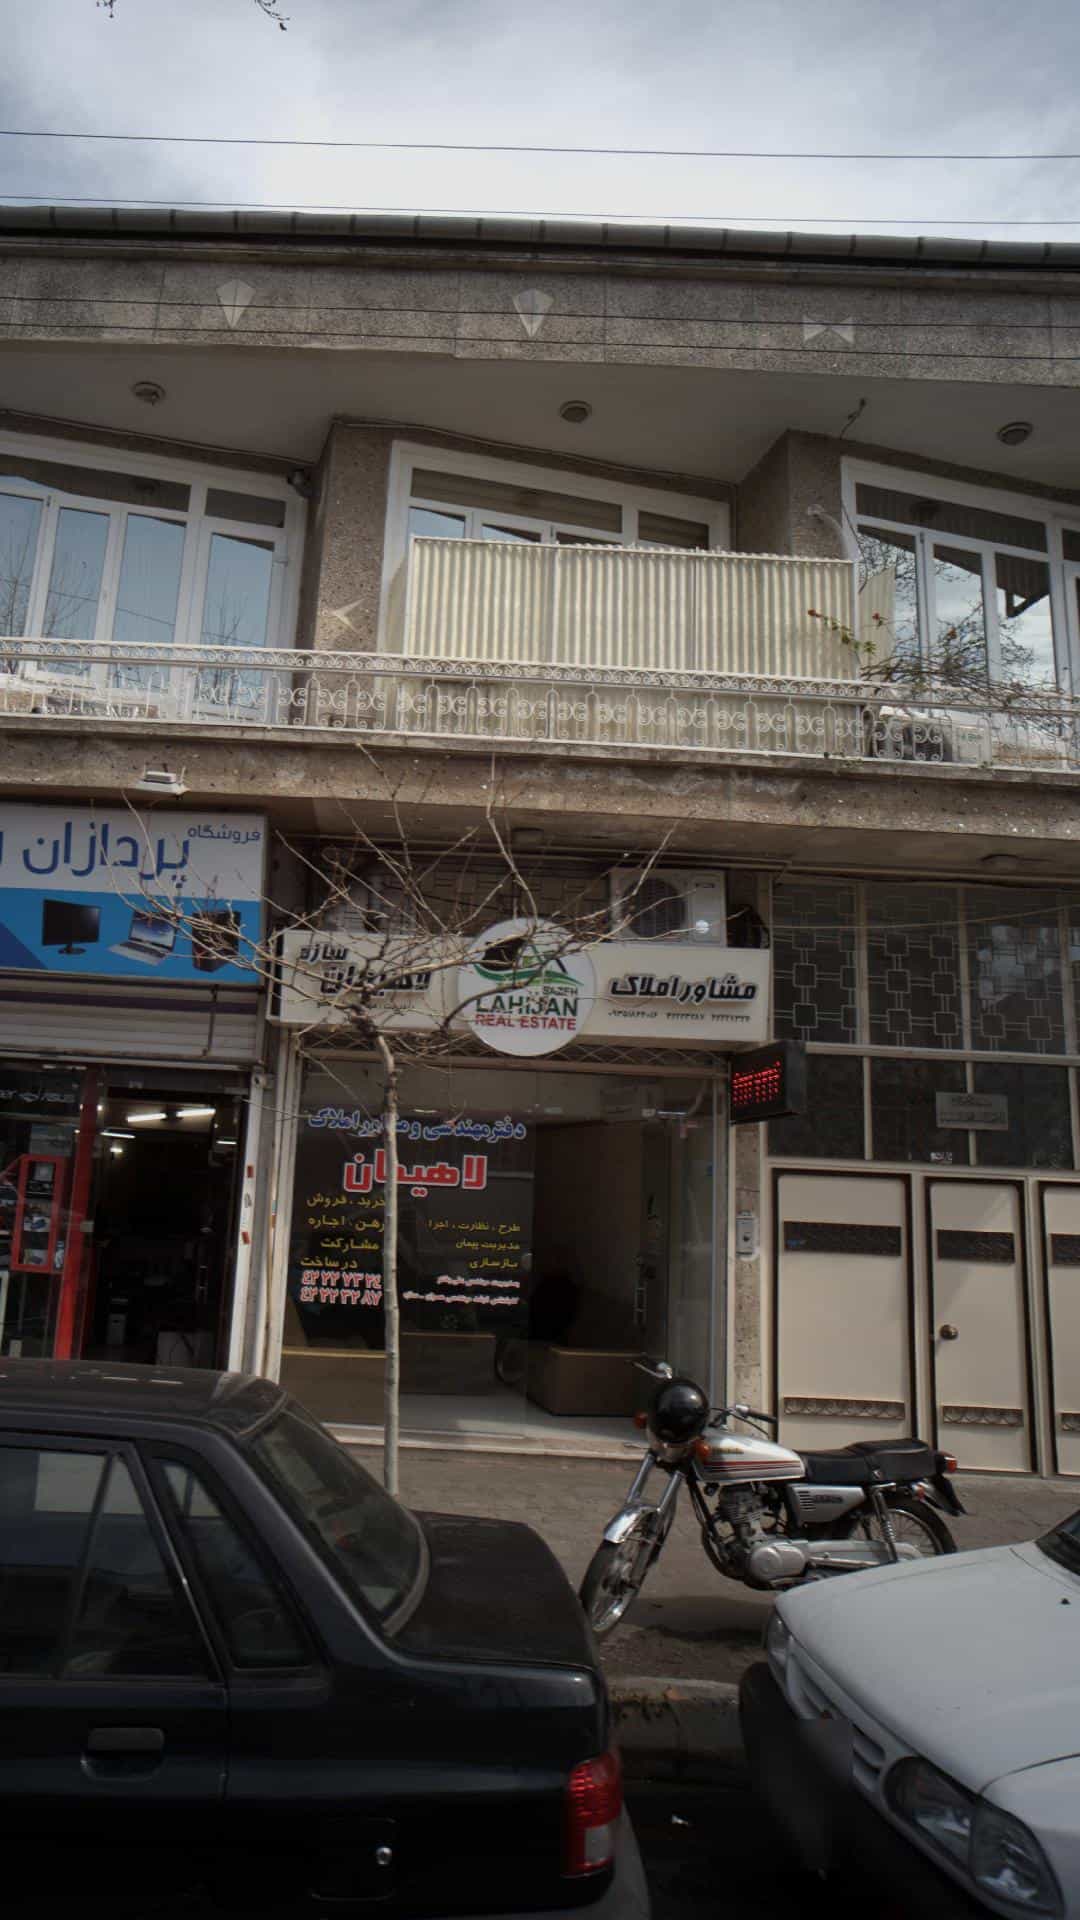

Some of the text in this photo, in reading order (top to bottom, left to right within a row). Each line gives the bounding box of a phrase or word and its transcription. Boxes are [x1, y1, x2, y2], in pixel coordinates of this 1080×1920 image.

[187, 823, 261, 845] فروشگاه
[22, 821, 190, 889] پردازان
[610, 974, 757, 1004] مشاور املاک
[476, 995, 578, 1017] LAHIJAN
[475, 1014, 577, 1031] REAL ESTATE
[408, 1121, 422, 1140] و
[424, 1119, 489, 1142] مهندسی
[487, 1114, 527, 1143] دفتر
[307, 1191, 347, 1208] فروش
[307, 1214, 345, 1229] اجاره
[320, 1236, 380, 1253] مشارکت
